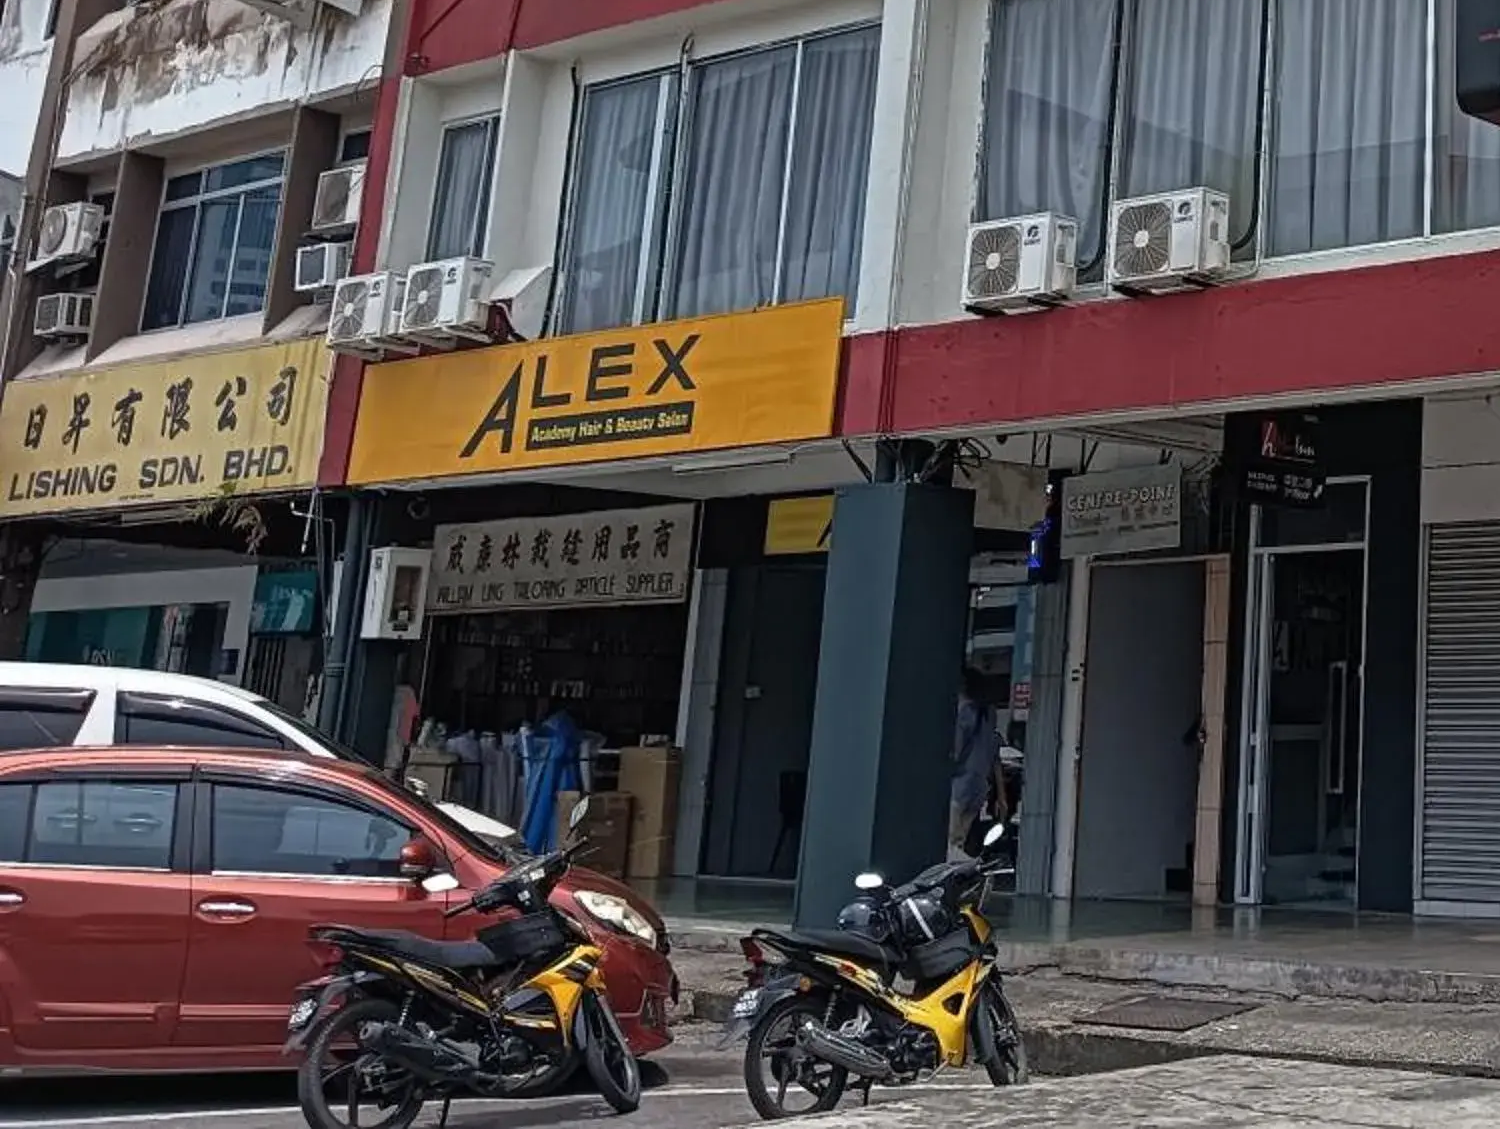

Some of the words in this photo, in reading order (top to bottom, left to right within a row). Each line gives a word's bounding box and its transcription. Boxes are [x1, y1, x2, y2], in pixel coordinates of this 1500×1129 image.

[458, 334, 701, 458] ALEX
[531, 426, 578, 444] Academy
[579, 422, 602, 438] Hair
[616, 416, 655, 434] Beauty
[8, 464, 118, 502] LISHING
[138, 454, 205, 490] SDN.
[222, 444, 293, 481] BHD.
